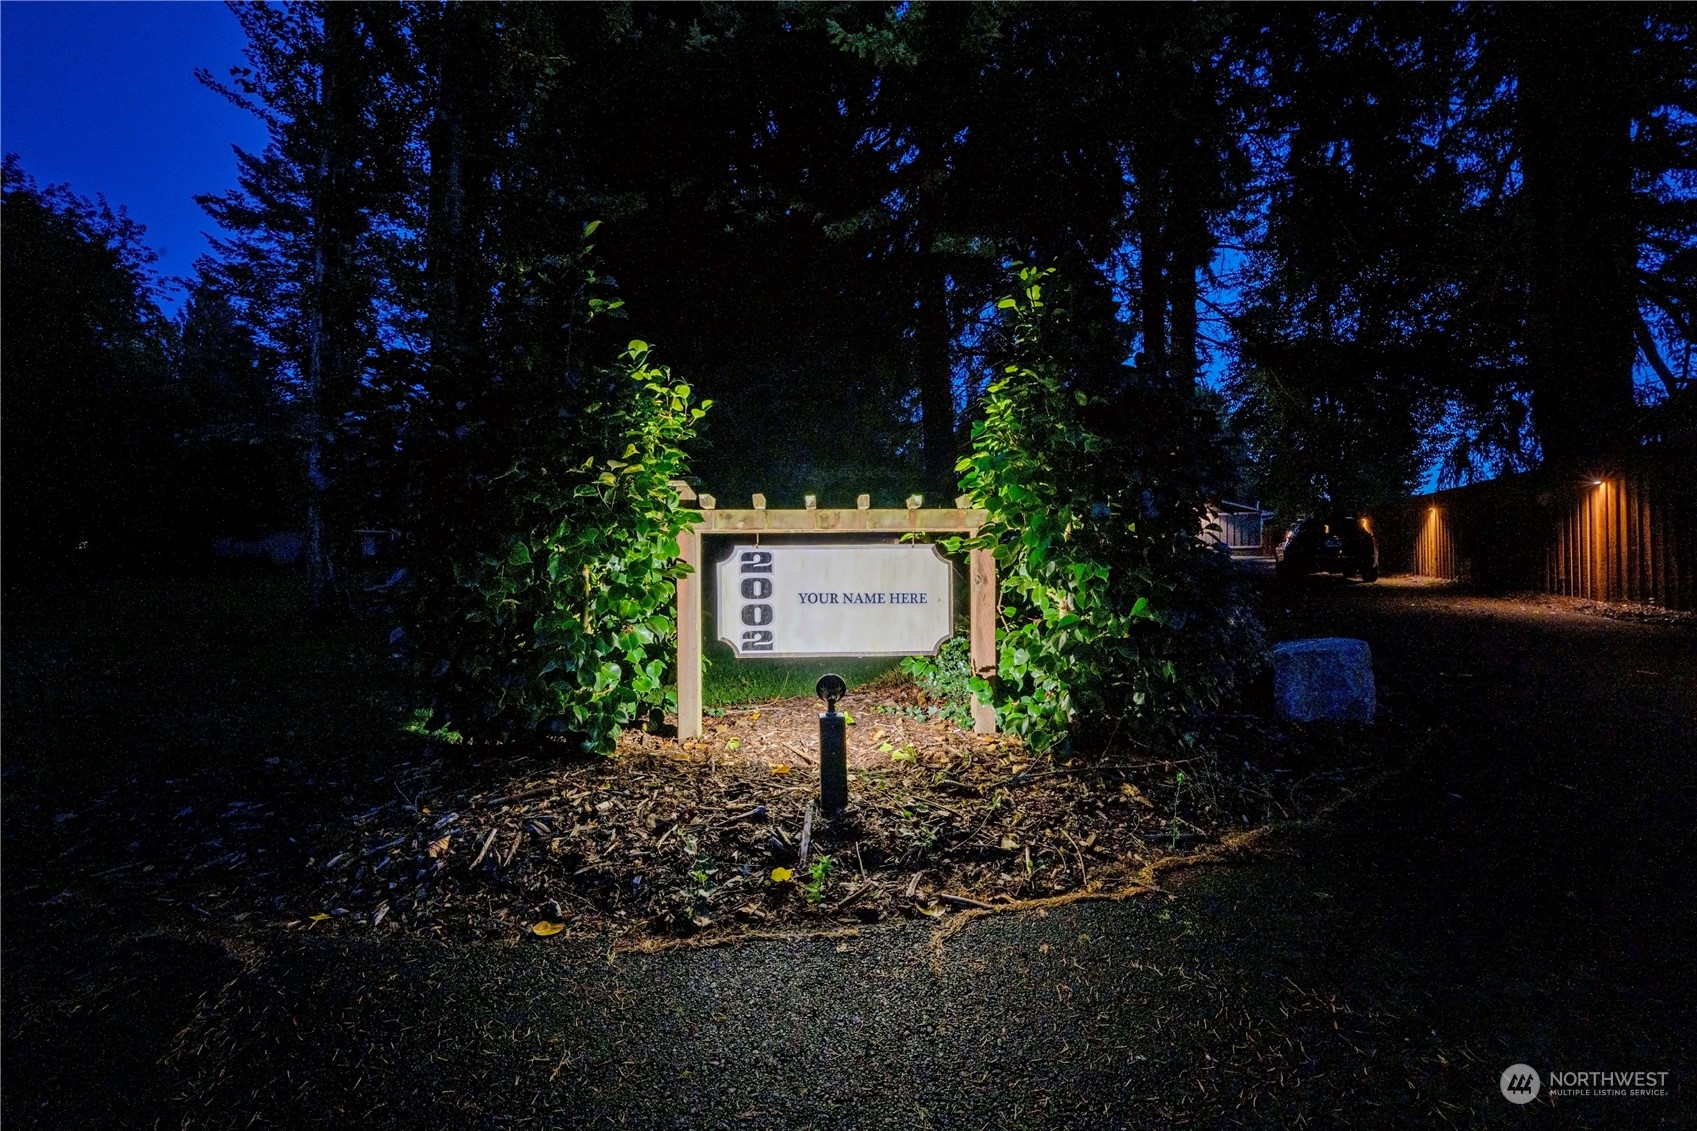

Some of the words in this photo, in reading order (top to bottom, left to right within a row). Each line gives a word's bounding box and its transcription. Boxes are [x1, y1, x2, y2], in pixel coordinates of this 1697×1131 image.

[740, 552, 773, 651] 2002
[798, 592, 838, 604] YOUR
[842, 592, 886, 604] NAME
[890, 592, 928, 604] HERE
